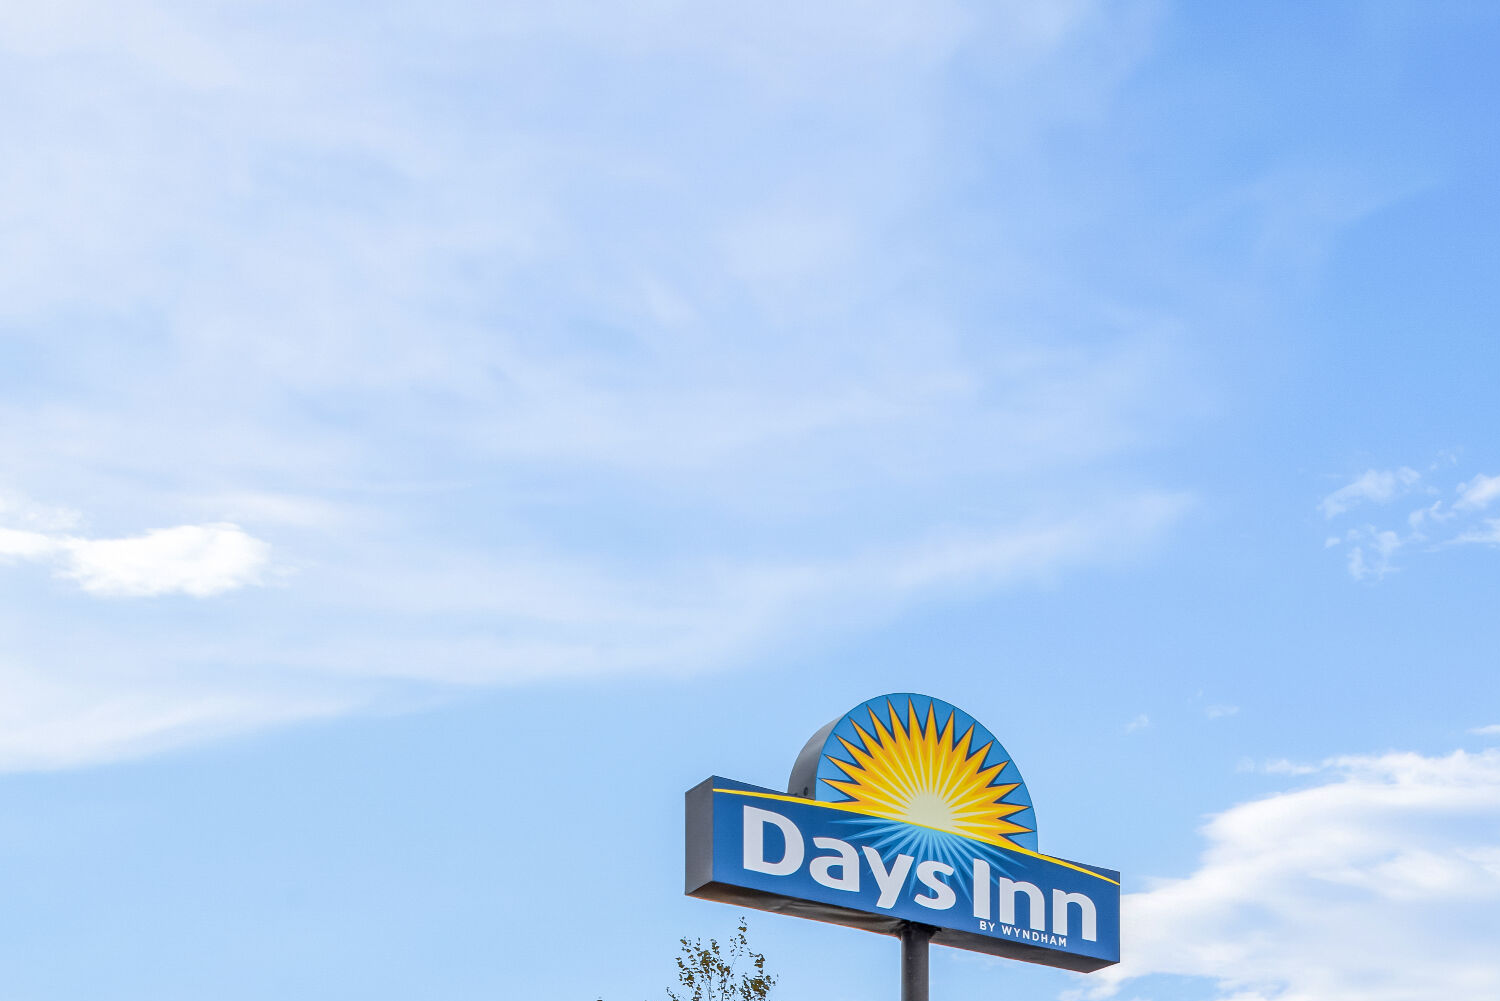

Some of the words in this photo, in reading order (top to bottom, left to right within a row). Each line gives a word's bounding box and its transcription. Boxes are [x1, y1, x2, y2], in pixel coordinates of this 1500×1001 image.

[743, 805, 956, 910] Days
[973, 858, 1097, 942] Inn
[980, 920, 995, 932] BY
[1001, 924, 1067, 947] WYNDHAM
